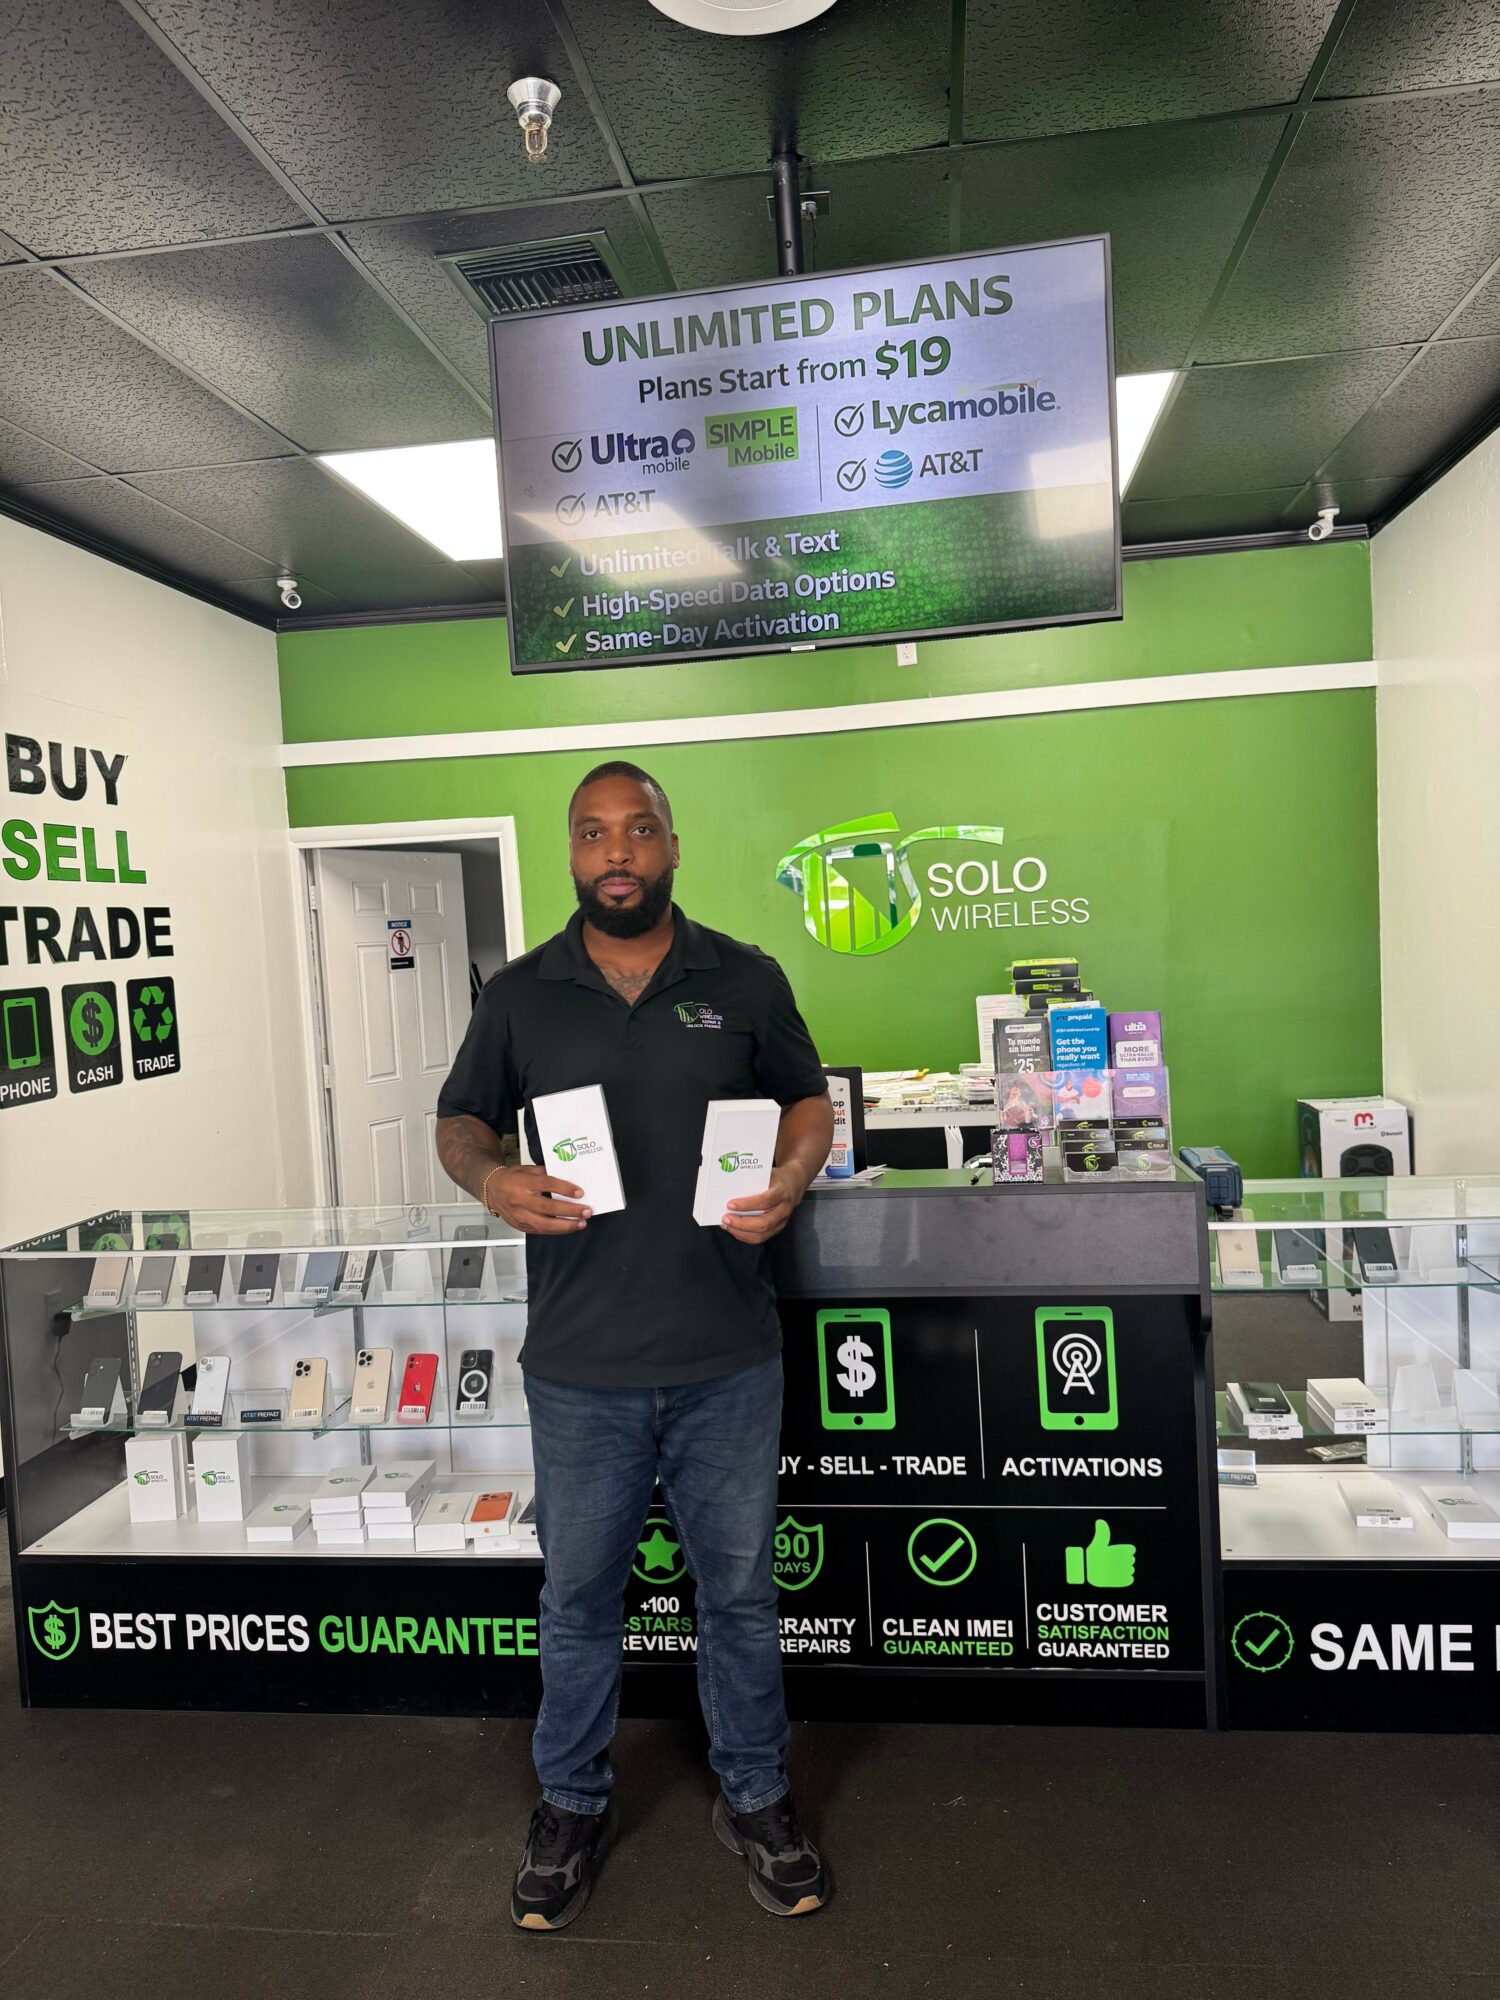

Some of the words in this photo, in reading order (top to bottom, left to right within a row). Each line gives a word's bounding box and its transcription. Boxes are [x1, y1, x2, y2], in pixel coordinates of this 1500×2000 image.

[582, 298, 835, 367] UNLIMITED
[853, 275, 1014, 331] PLANS
[638, 375, 713, 403] Plans
[718, 363, 790, 393] Start
[797, 358, 866, 384] from
[875, 336, 951, 380] $19
[871, 383, 1057, 435] Lycamobile
[709, 415, 795, 445] SIMPLE
[590, 432, 668, 466] Ultra
[734, 443, 795, 465] Mobile
[642, 459, 690, 475] mobile
[919, 448, 984, 478] AT&T
[593, 489, 656, 518] AT&T
[579, 542, 699, 577] Unlimited
[707, 537, 760, 561] Talk
[765, 536, 781, 557] &
[785, 529, 841, 555] Text
[582, 582, 724, 620] High-Speed
[731, 577, 788, 603] Data
[794, 568, 896, 600] Options
[585, 622, 708, 652] Same-Day
[714, 611, 840, 640] Activation
[5, 732, 128, 806] BUY
[1, 819, 147, 884] SELL
[927, 857, 1048, 898] SOLO
[930, 898, 1090, 932] WIRELESS
[0, 906, 174, 965] TRADE
[1068, 1013, 1092, 1022] prepaid
[1017, 1037, 1040, 1045] mundo
[1056, 1046, 1081, 1054] phone
[1082, 1046, 1097, 1054] you
[1124, 1045, 1149, 1053] MORE
[137, 1053, 176, 1074] TRADE
[1013, 1058, 1035, 1073] $25
[1056, 1053, 1079, 1062] really
[77, 1065, 114, 1086] CASH
[0, 1077, 52, 1101] PHONE
[577, 1141, 596, 1150] SOLO
[777, 1456, 801, 1475] UY
[820, 1456, 874, 1475] SELL
[892, 1456, 967, 1475] TRADE
[1001, 1457, 1163, 1477] ACTIVATIONS
[774, 1533, 810, 1559] 90
[773, 1562, 811, 1574] DAYS
[640, 1597, 680, 1613] +100
[1036, 1603, 1168, 1622] CUSTOMER
[89, 1612, 177, 1650] BEST
[187, 1614, 310, 1652] PRICES
[318, 1615, 539, 1655] GUARANTEE
[624, 1616, 693, 1633] -STARS
[882, 1618, 960, 1637] CLEAN
[967, 1619, 1014, 1638] IMEI
[1037, 1624, 1169, 1641] SATISFACTION
[883, 1639, 1014, 1656] GUARANTEED
[1037, 1642, 1170, 1659] GUARANTEED
[1310, 1623, 1475, 1671] SAME
